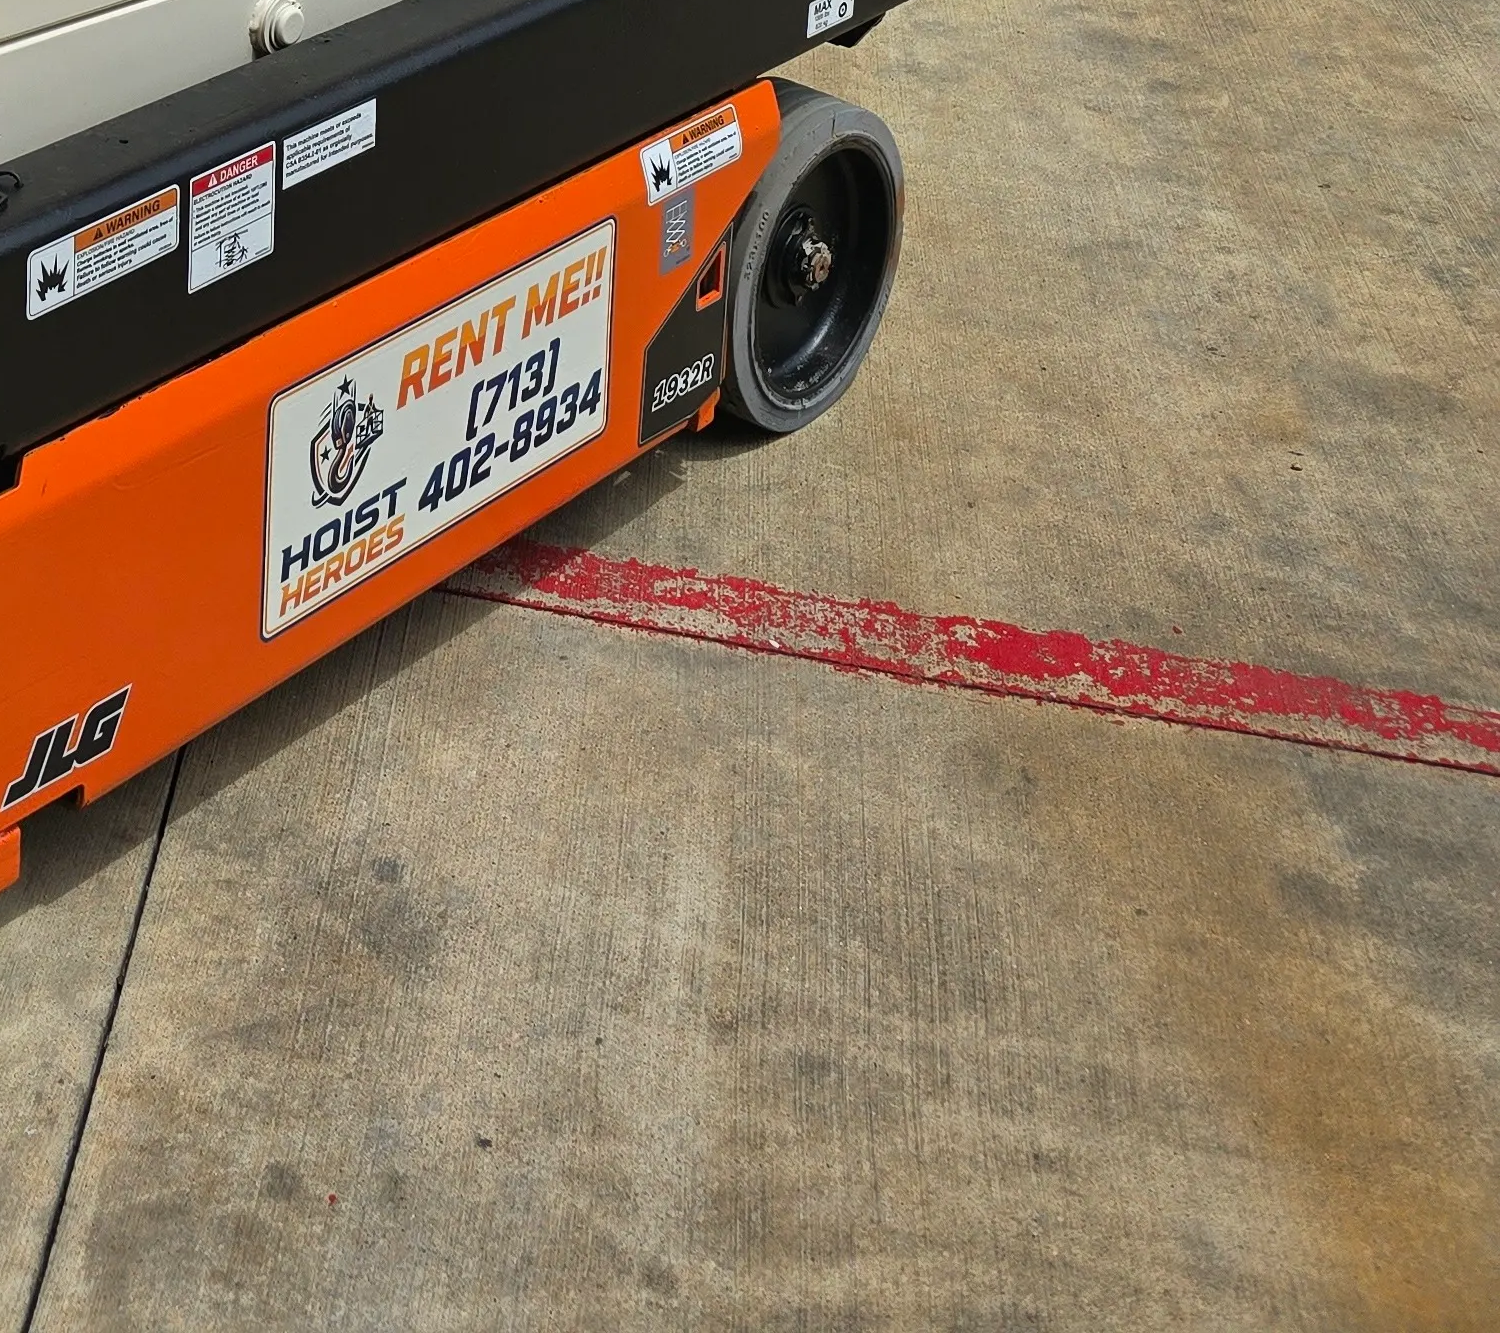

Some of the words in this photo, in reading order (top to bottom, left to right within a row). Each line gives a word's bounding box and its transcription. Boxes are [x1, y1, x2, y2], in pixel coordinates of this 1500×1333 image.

[220, 154, 258, 183] DANGER
[688, 115, 725, 141] WARNING
[106, 199, 160, 235] WARNING
[397, 294, 516, 411] RENT
[521, 246, 608, 340] ME!!
[652, 353, 714, 412] 1932R
[418, 368, 602, 513] 402-8934
[279, 513, 405, 619] HEROES
[280, 477, 408, 583] HOIST
[0, 683, 132, 813] JLG
